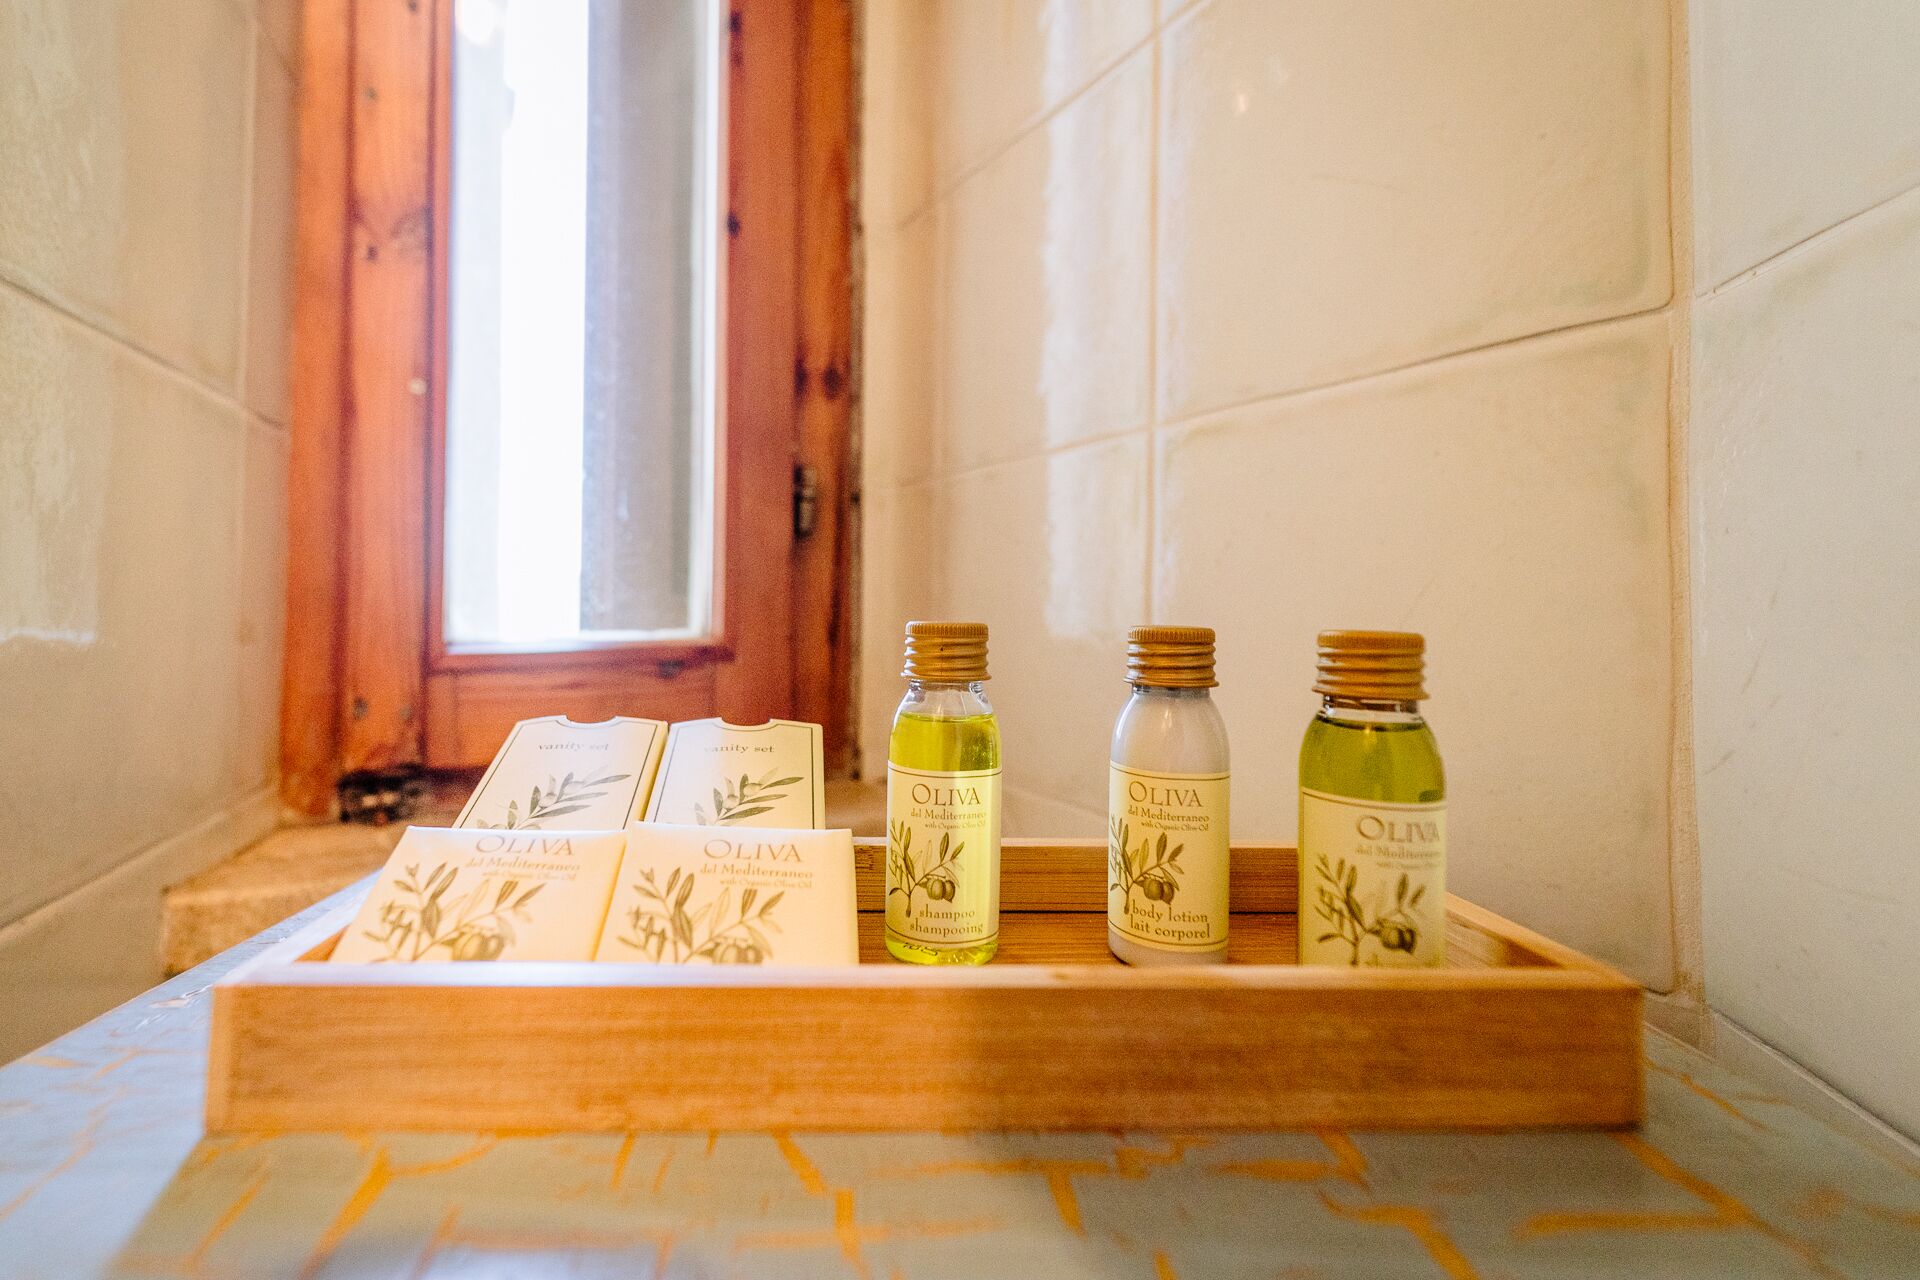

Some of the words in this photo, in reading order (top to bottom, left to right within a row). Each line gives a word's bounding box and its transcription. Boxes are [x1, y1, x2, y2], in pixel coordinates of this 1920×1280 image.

[753, 744, 775, 753] set
[912, 783, 981, 807] OLIVA
[1128, 781, 1203, 808] OLIVA
[910, 807, 922, 818] del
[924, 808, 987, 820] Mediterraneo
[1127, 804, 1139, 817] del
[1140, 807, 1210, 823] Mediterraneo
[476, 835, 573, 856] OLIVA
[704, 839, 802, 863] OLIVA
[486, 856, 580, 871] Mediterraneo
[700, 863, 717, 875] del
[721, 863, 813, 879] Mediterraneo
[919, 904, 975, 922] shampoo
[1132, 899, 1163, 922] body
[1168, 907, 1208, 923] lotion
[909, 917, 984, 938] shampooing
[1130, 914, 1151, 934] lait
[1154, 923, 1210, 941] corporel
